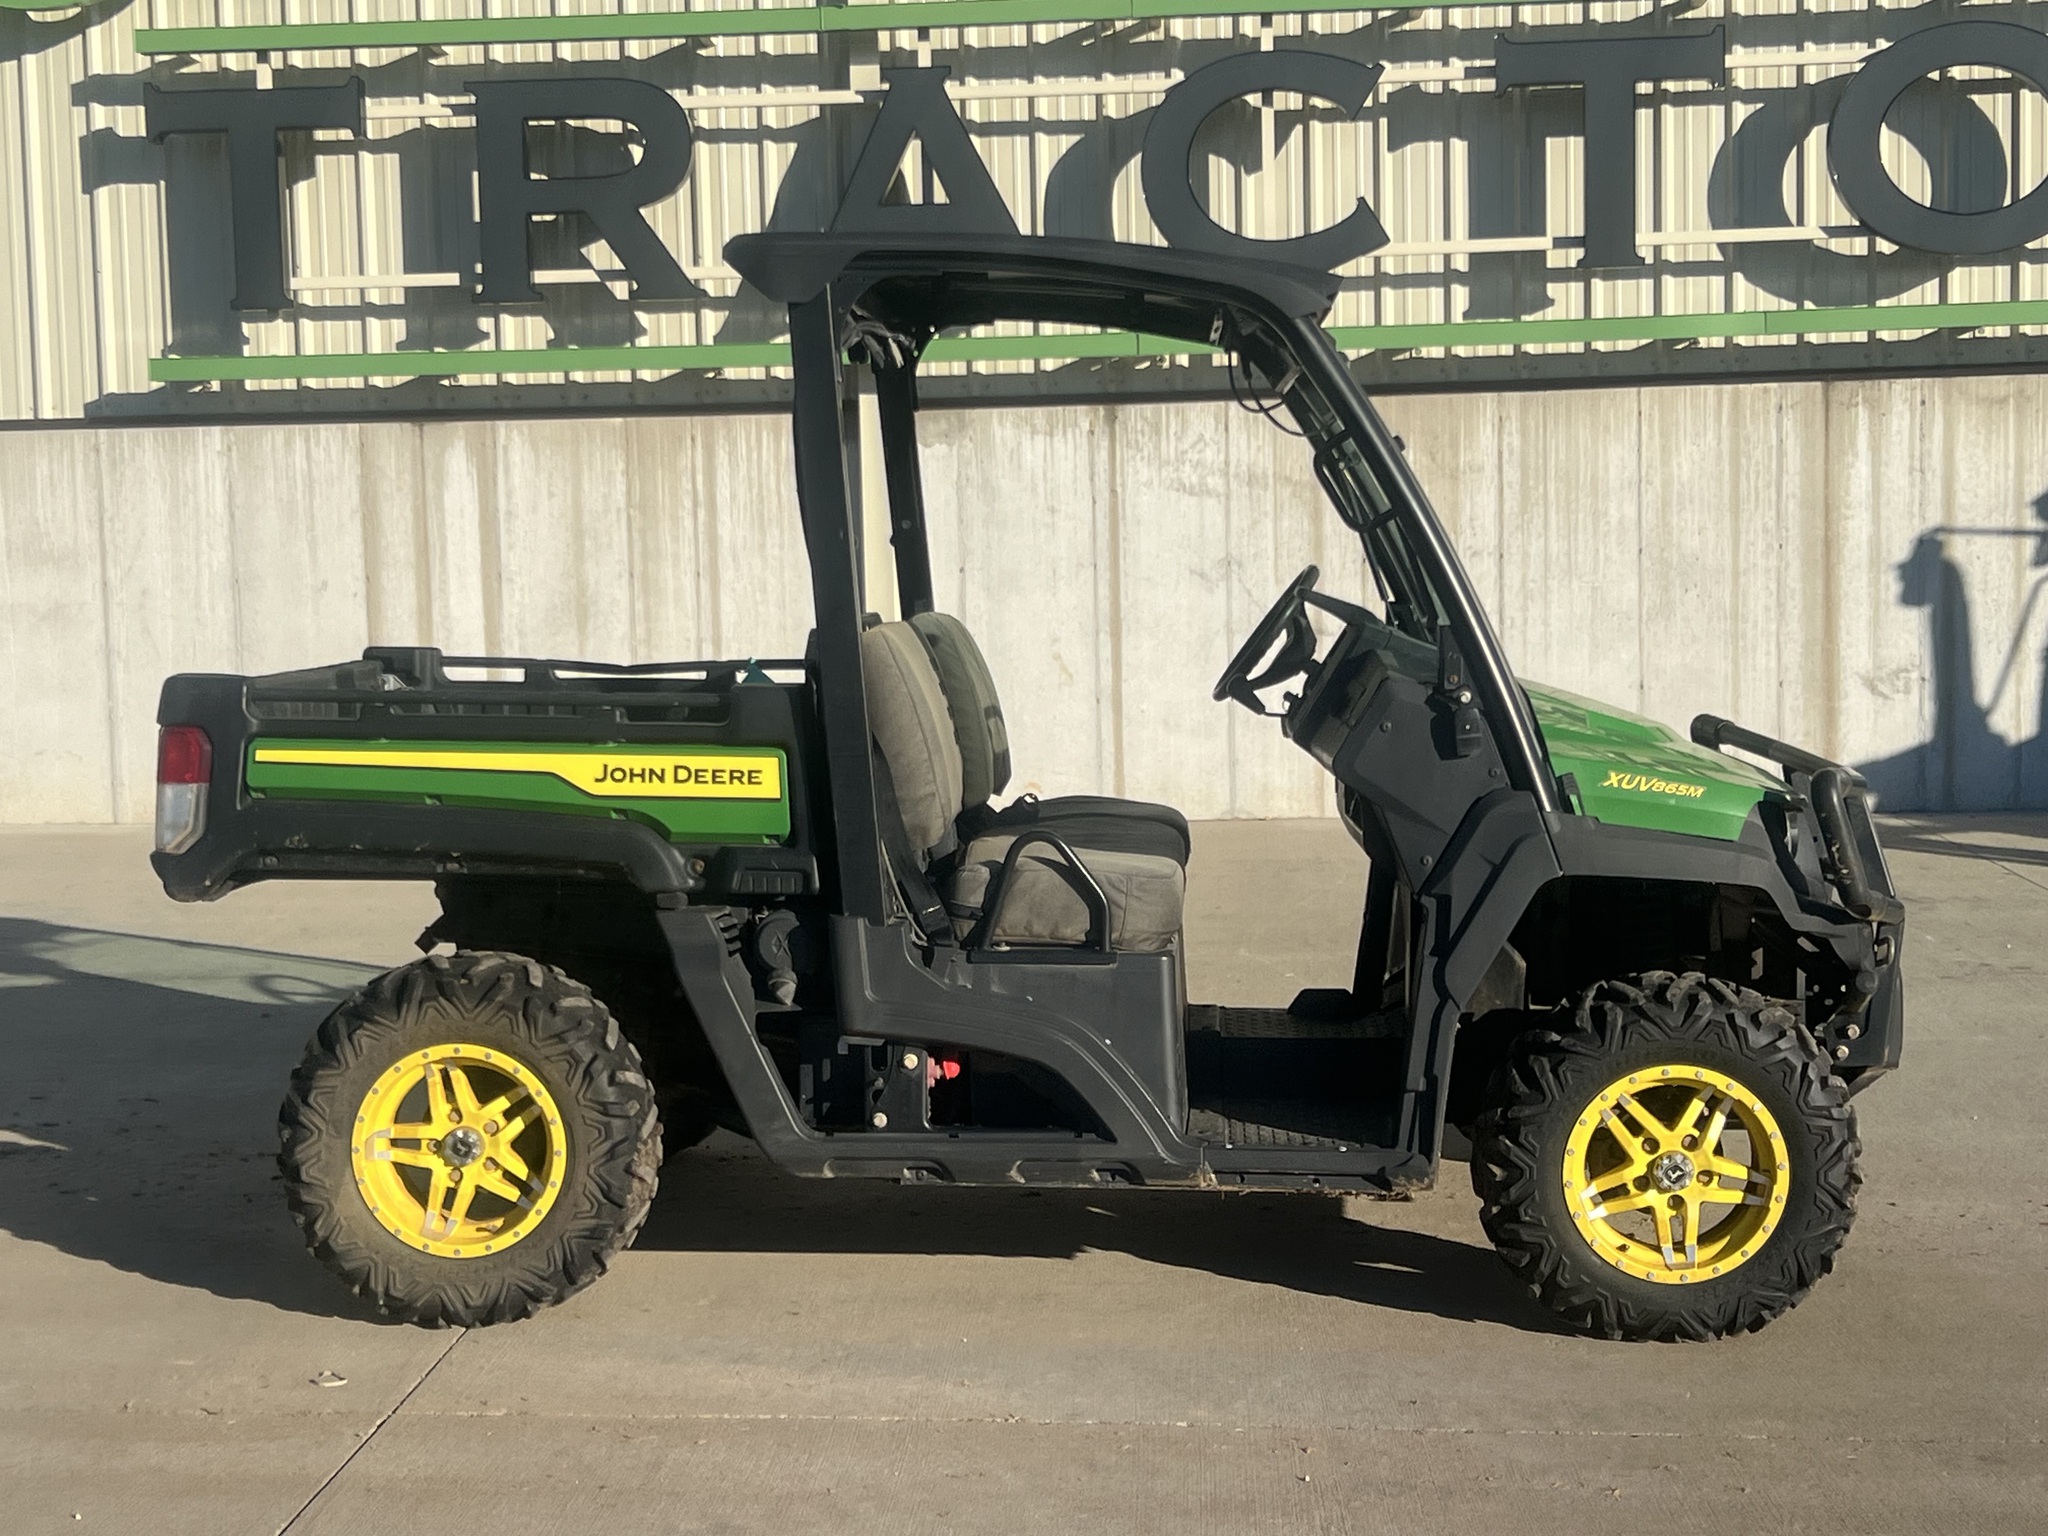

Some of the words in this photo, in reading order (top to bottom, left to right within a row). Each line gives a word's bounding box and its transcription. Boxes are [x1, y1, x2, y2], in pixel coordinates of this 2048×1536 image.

[143, 21, 2048, 310] TRACTO
[594, 763, 666, 784] JOHN
[673, 764, 763, 785] DEERE
[1602, 771, 1706, 798] XUV865M
